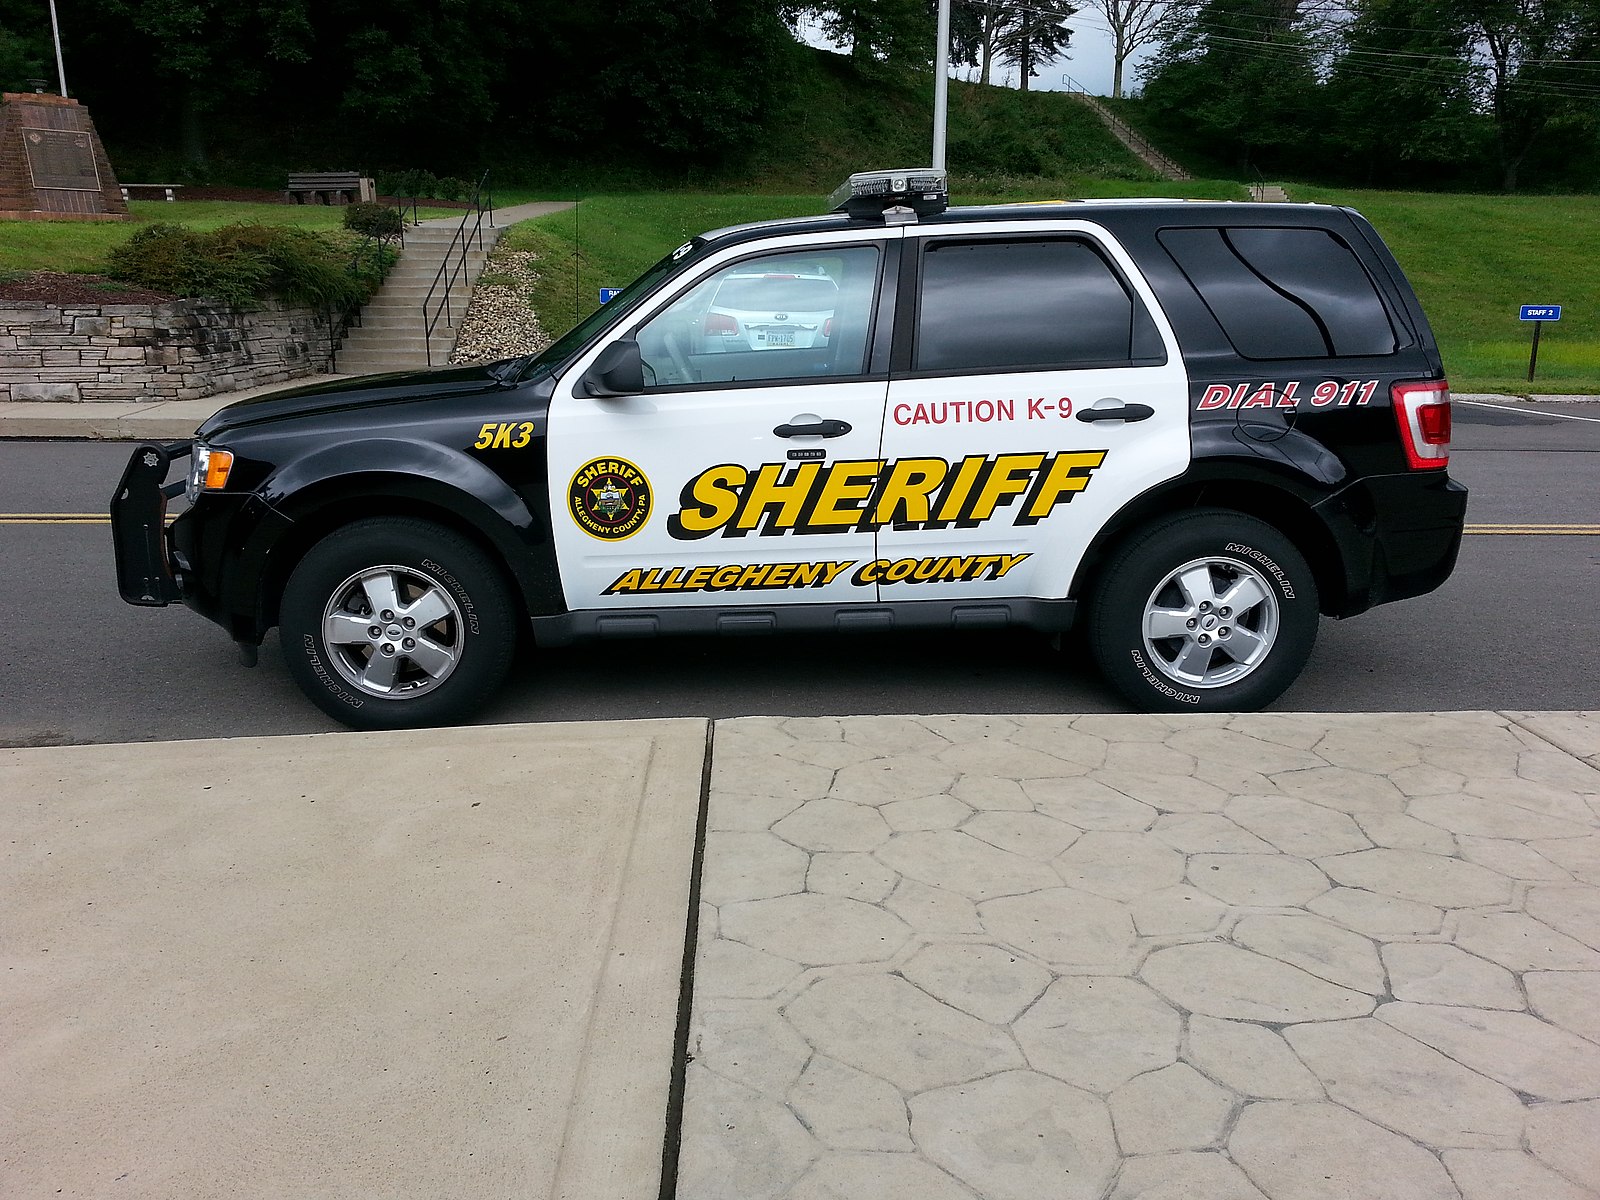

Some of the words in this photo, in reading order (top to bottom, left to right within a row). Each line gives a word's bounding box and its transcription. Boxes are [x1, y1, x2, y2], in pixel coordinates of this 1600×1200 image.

[893, 399, 1014, 426] CAUTION
[1027, 397, 1073, 420] K-9
[1196, 381, 1300, 411] DIAL
[1310, 380, 1379, 407] 911
[474, 421, 535, 449] 5K3
[577, 462, 643, 487] SHERIFF
[667, 449, 1109, 541] SHERIFF
[574, 496, 611, 534] ALLEGHENY
[638, 494, 646, 506] PA
[599, 559, 860, 595] ALLEGHENY
[850, 552, 1034, 587] COUNTY
[1225, 542, 1296, 600] MICHELIN
[421, 558, 481, 635] MICHELIN
[303, 633, 364, 709] MICHELIN
[1131, 650, 1201, 704] MICHELIN
